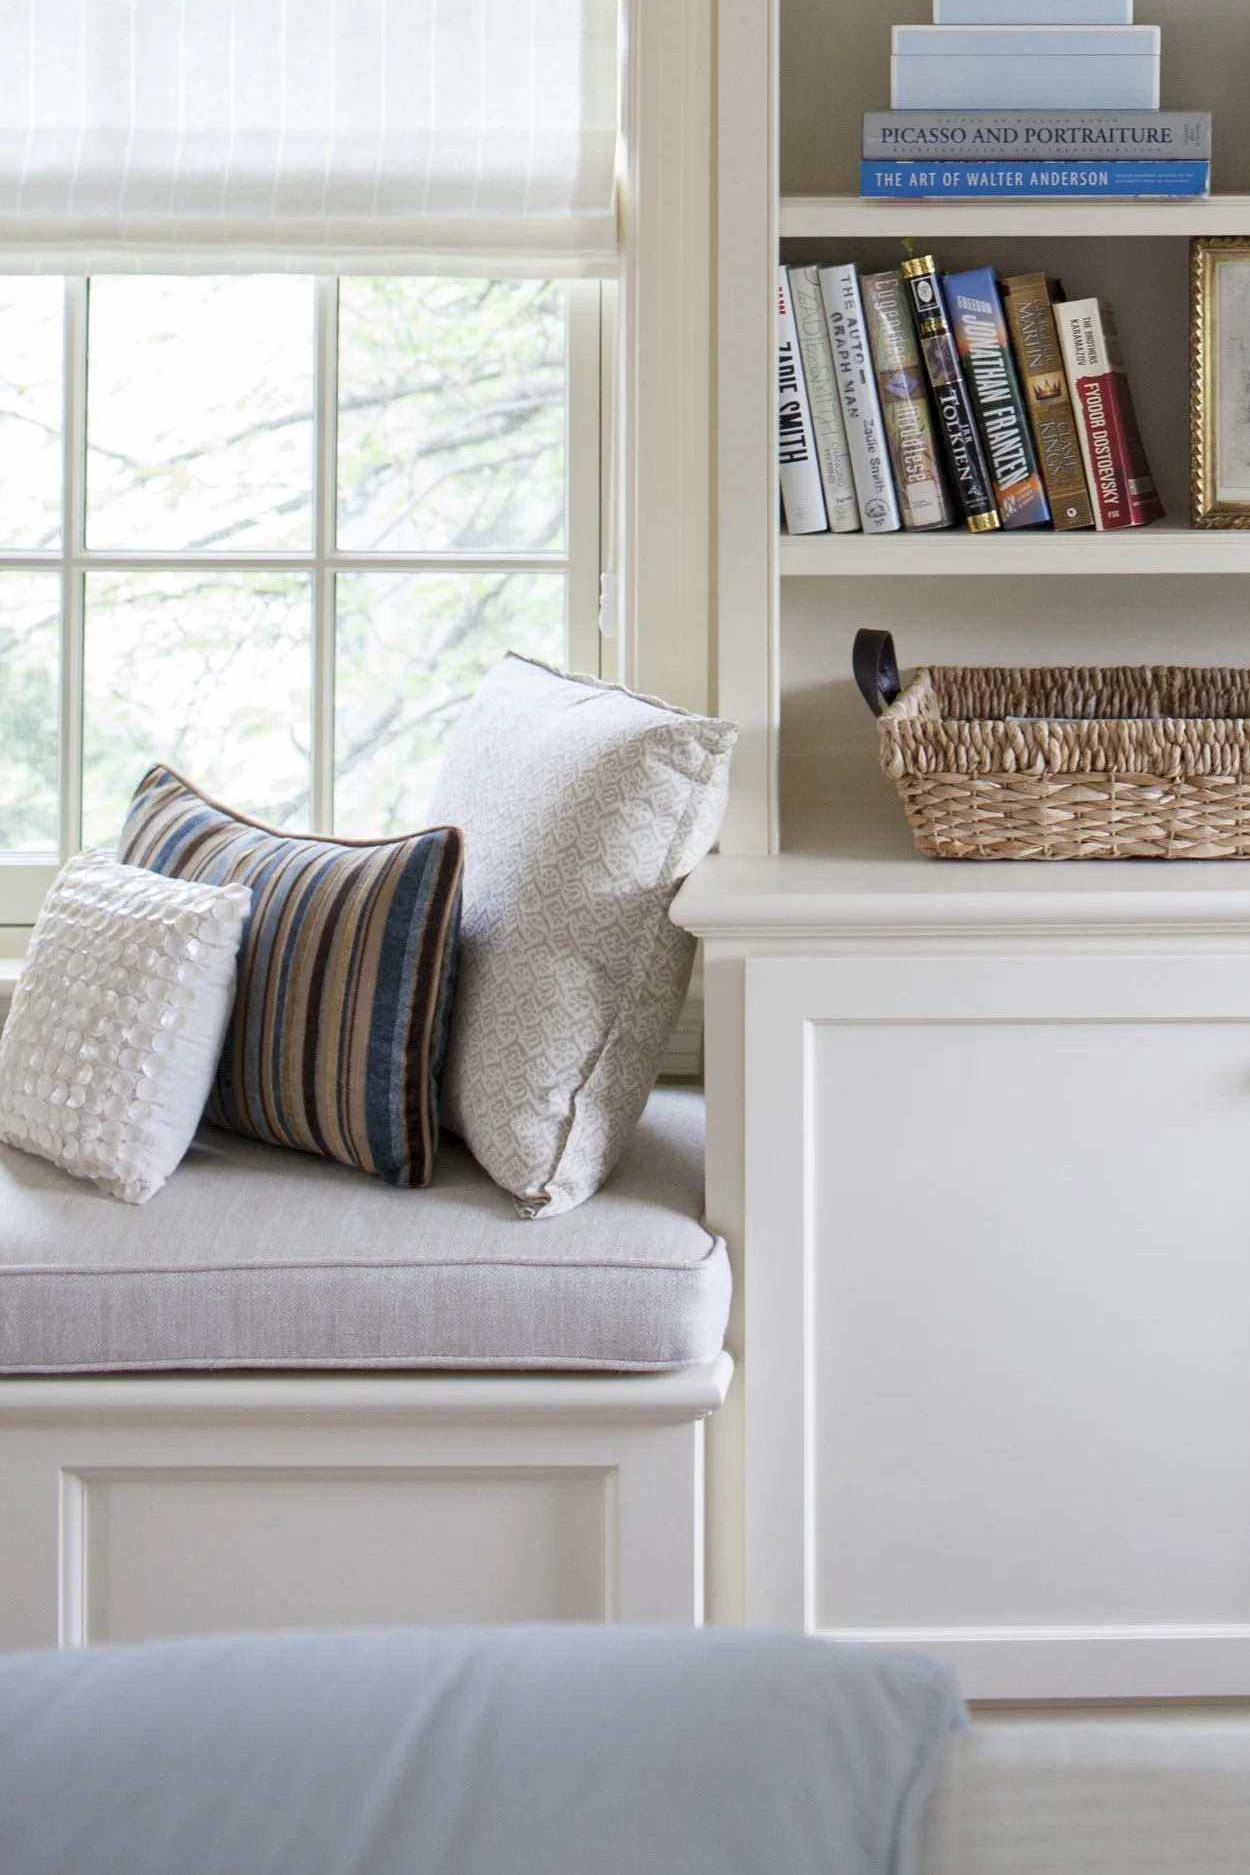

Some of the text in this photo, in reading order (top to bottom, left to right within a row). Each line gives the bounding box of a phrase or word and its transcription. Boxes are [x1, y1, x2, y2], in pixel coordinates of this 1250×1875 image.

[880, 127, 1173, 144] PICASSO AND PORTRAITURE
[876, 171, 1108, 187] THE ART OF WALTER ANDERSON
[840, 275, 856, 311] THE
[957, 295, 993, 314] FREEDOM
[961, 314, 1012, 404] JONATHAN
[1018, 302, 1045, 368] MARTIN
[1070, 319, 1086, 366] KARAMAZOV
[1082, 317, 1098, 365] THE BROTHERS
[830, 311, 860, 418] GRAPH MAN
[780, 401, 808, 464] SMITH
[863, 419, 886, 494] Zadie Smith
[896, 404, 927, 483] Middlese
[940, 389, 973, 481] TOLKIEN
[960, 423, 972, 443] JRR
[982, 406, 1029, 493] FRANZEN
[1040, 421, 1063, 475] KINGS
[1056, 421, 1077, 467] CLASH
[1083, 382, 1120, 505] FYODOR DOSTOEVSKY
